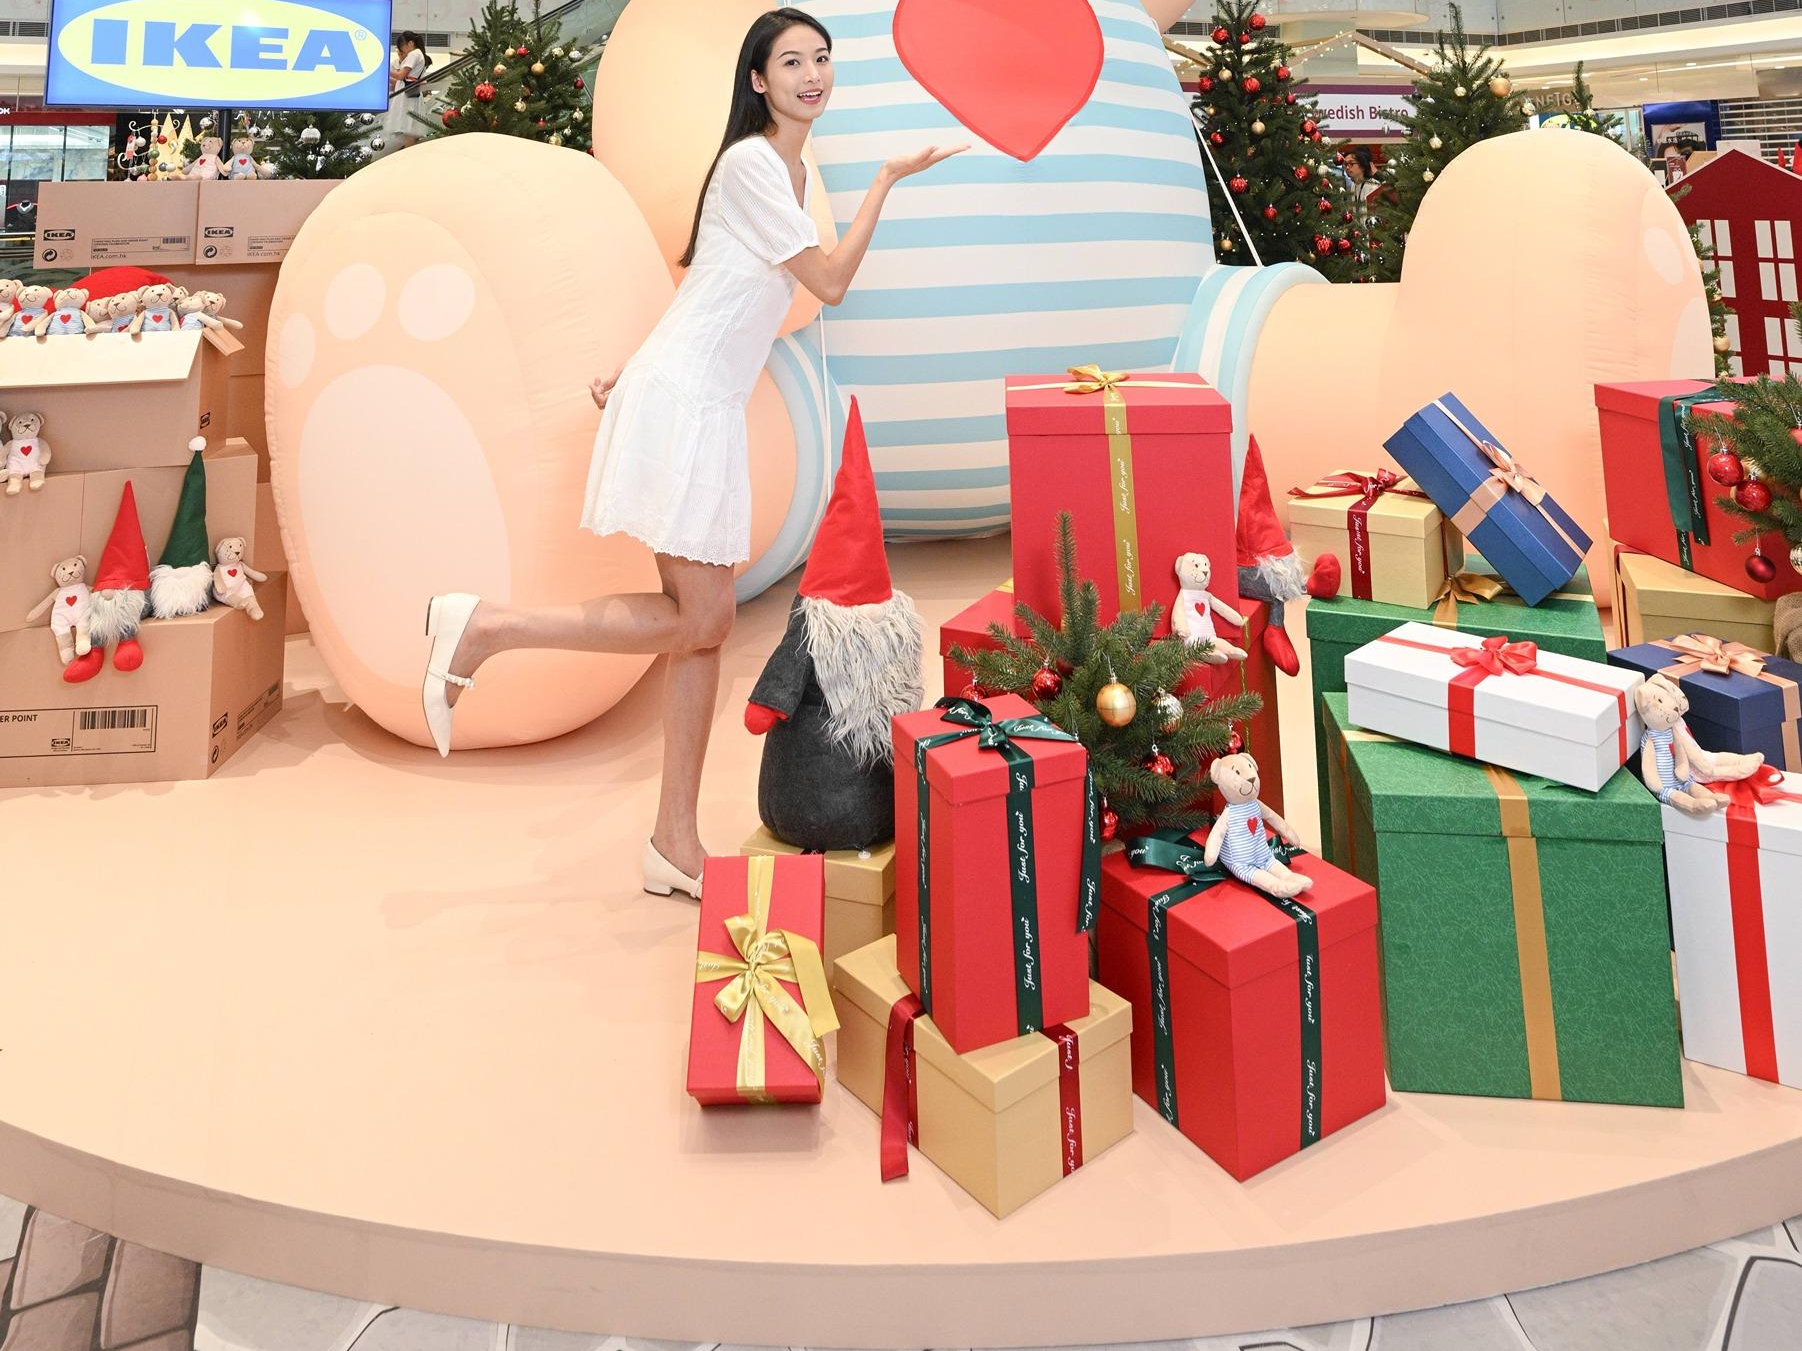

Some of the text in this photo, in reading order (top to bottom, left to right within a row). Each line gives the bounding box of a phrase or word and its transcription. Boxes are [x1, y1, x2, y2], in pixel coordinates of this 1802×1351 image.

[91, 18, 364, 73] IKEA
[1312, 105, 1409, 120] wedish Bistro
[1118, 460, 1129, 513] Just for you
[1355, 539, 1364, 555] for
[1124, 541, 1135, 595] Just for you
[1355, 554, 1364, 573] you
[11, 714, 38, 724] POINT
[1016, 812, 1030, 883] Just for you
[1085, 878, 1095, 927] Just for
[1022, 919, 1035, 990] Just for you
[1305, 975, 1314, 998] for
[1306, 998, 1314, 1023] you
[1306, 1059, 1316, 1135] Just for you
[1066, 1107, 1076, 1136] Just
[1067, 1133, 1077, 1157] for
